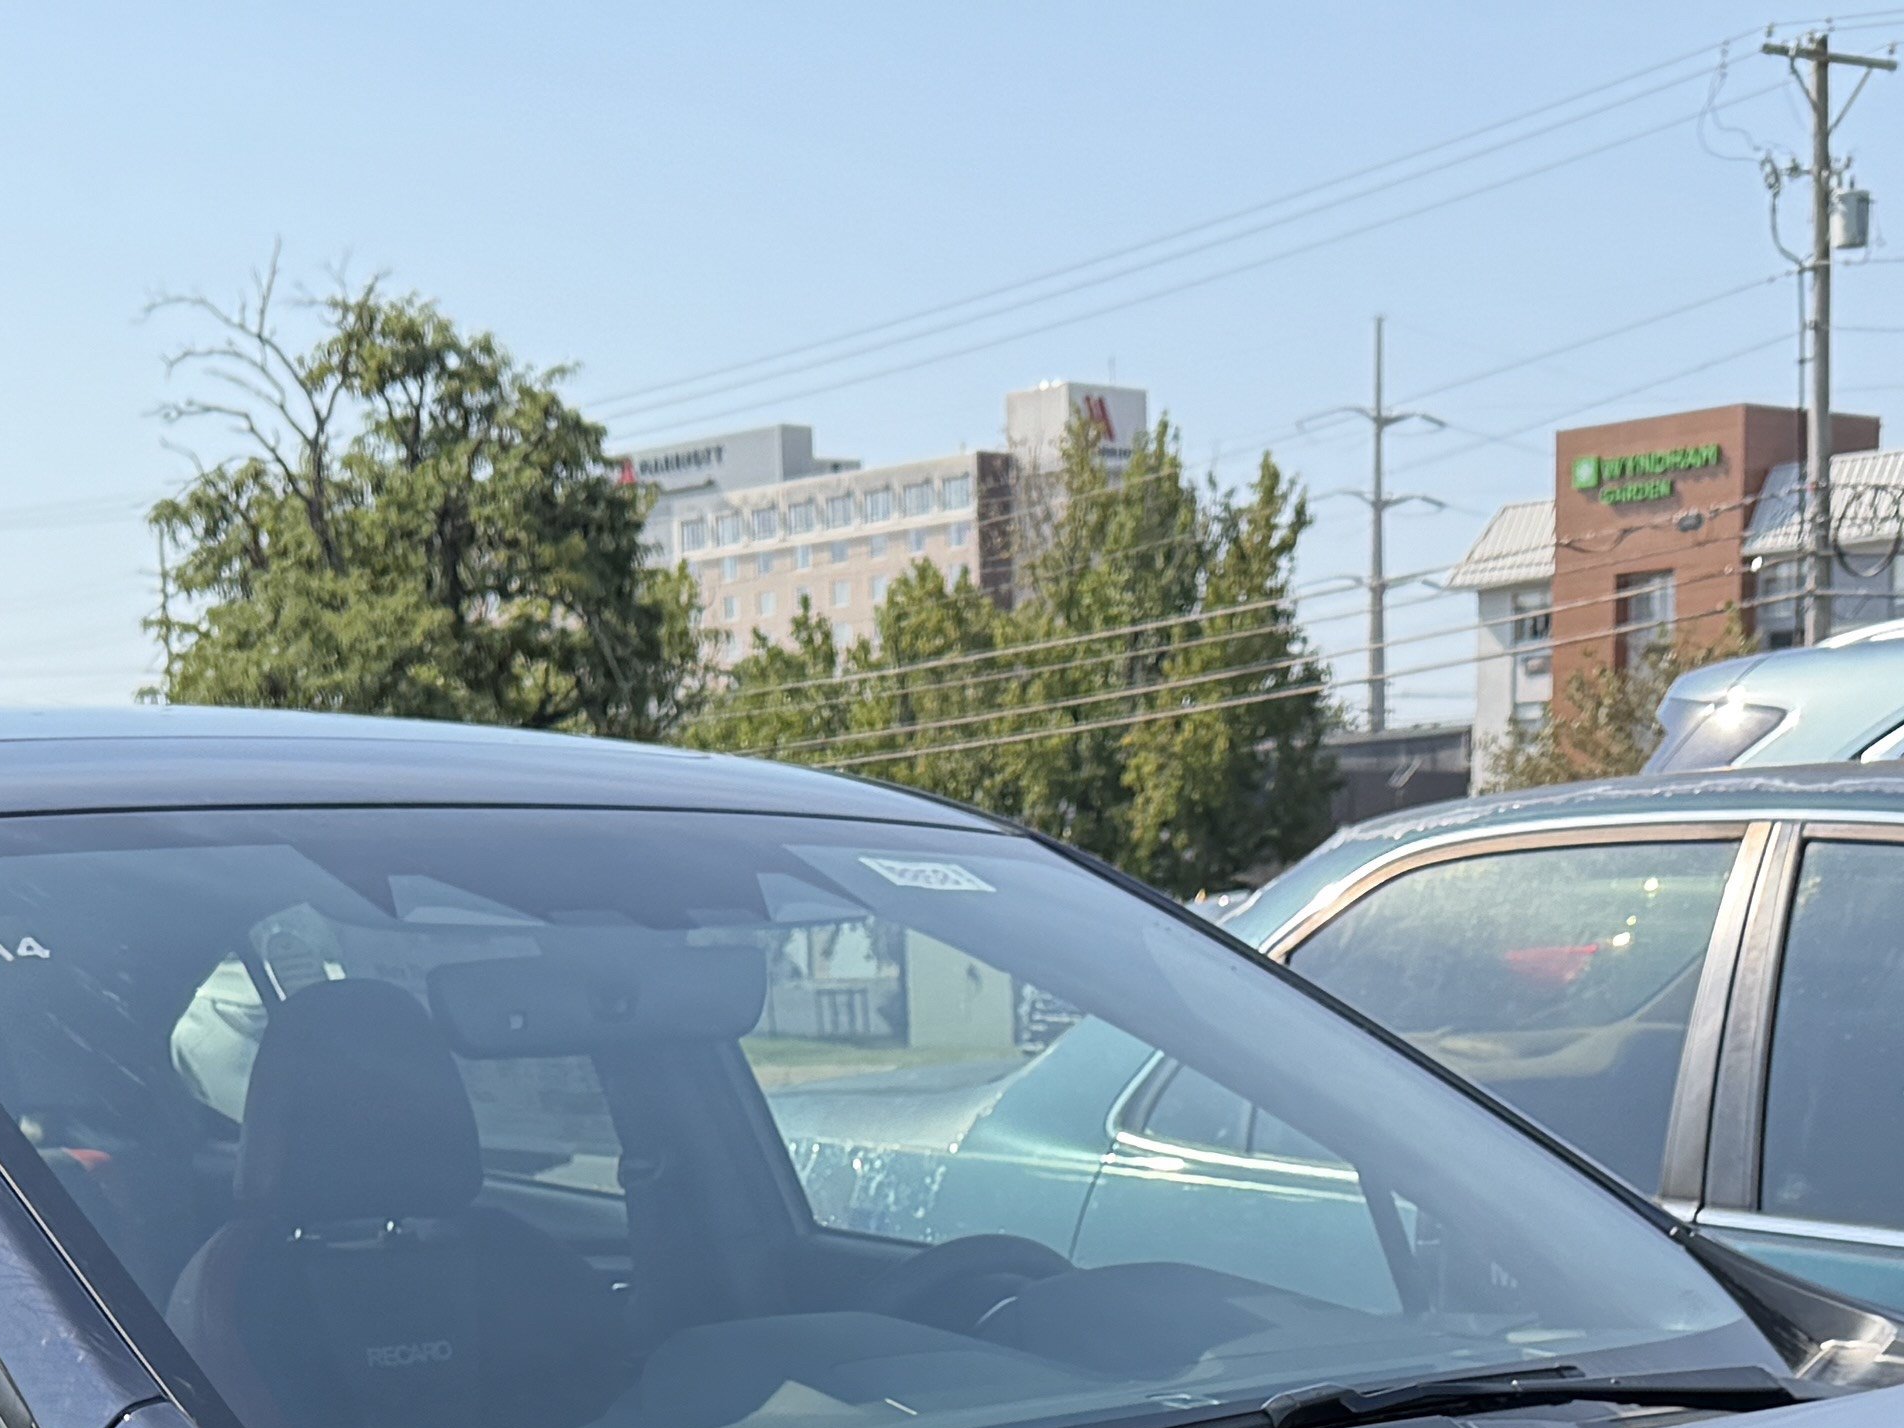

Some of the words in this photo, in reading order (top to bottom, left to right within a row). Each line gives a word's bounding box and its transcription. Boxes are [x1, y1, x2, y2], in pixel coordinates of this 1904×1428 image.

[1600, 443, 1720, 481] WYNDHAM
[1599, 479, 1672, 506] GARDEN
[366, 1340, 453, 1367] RECARO
